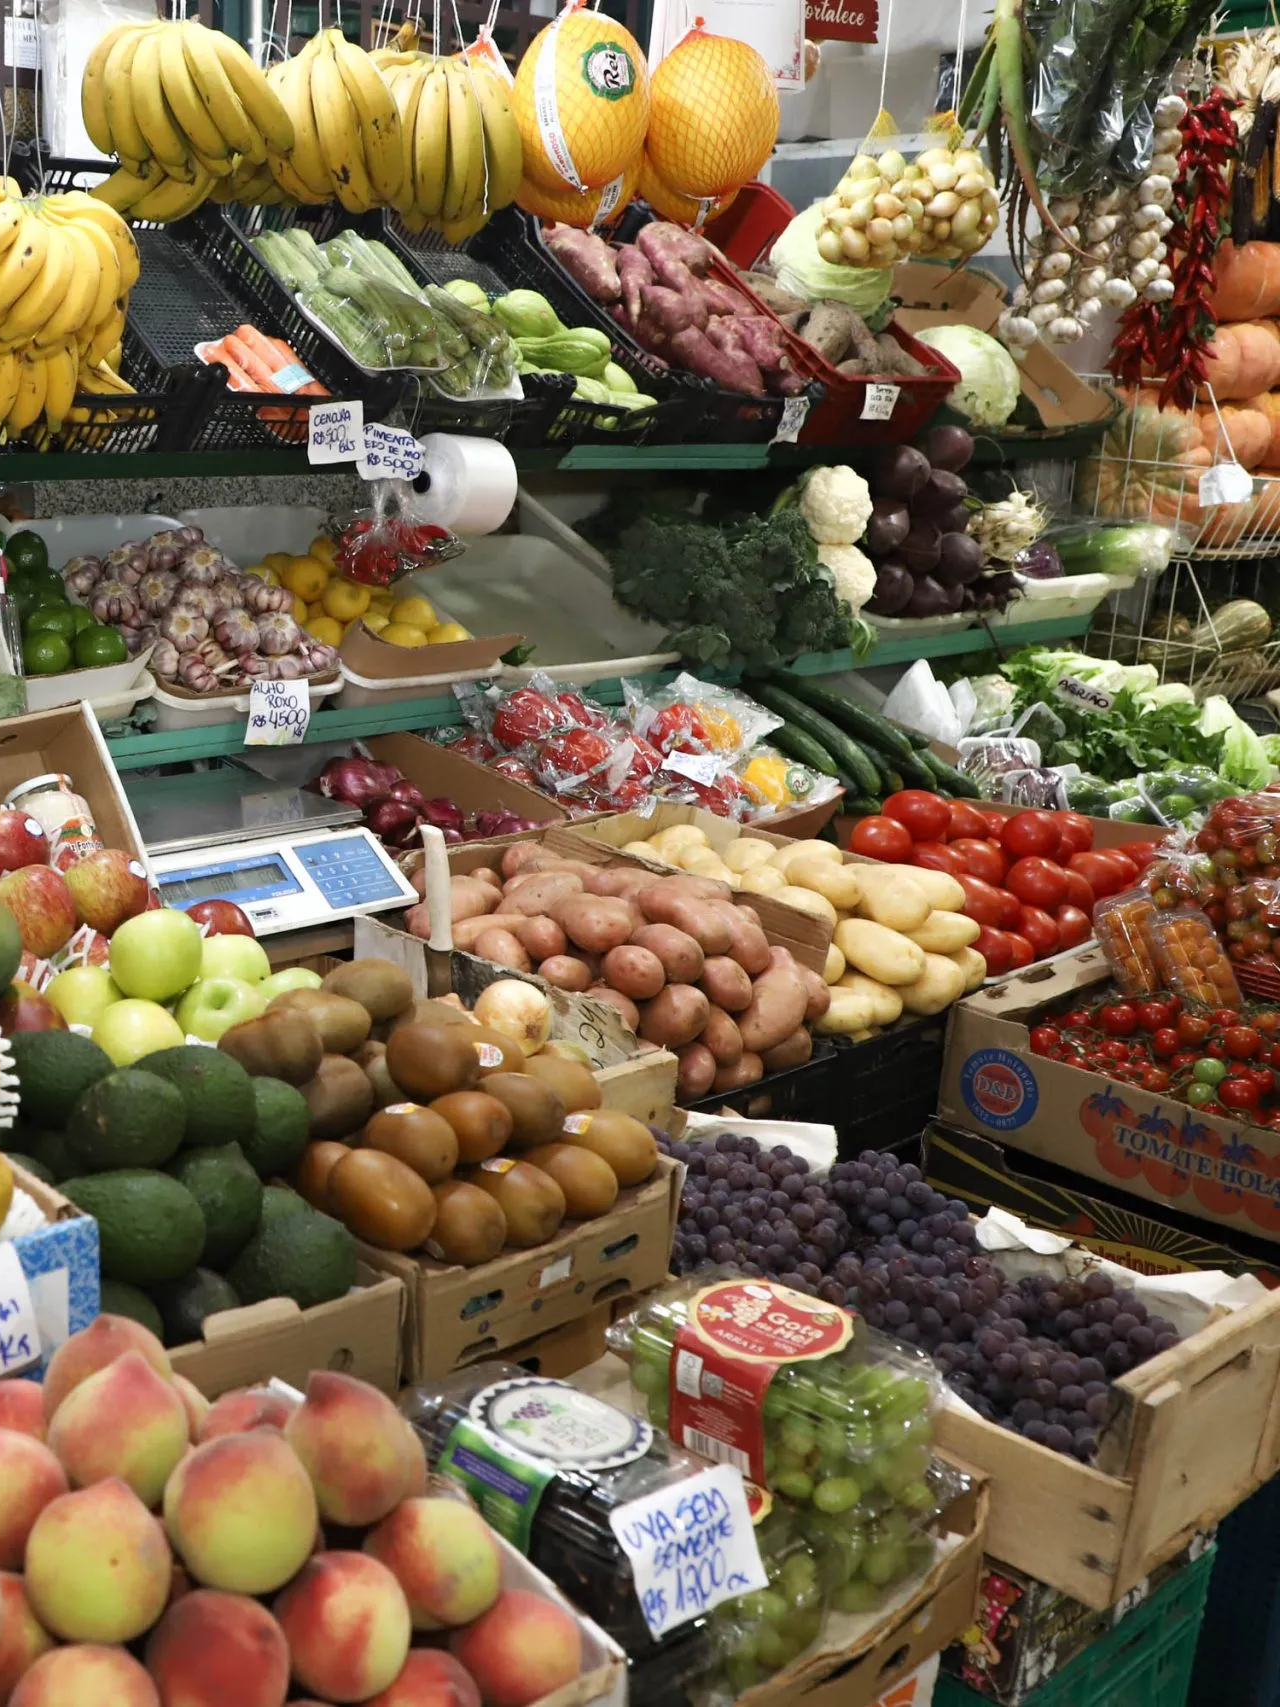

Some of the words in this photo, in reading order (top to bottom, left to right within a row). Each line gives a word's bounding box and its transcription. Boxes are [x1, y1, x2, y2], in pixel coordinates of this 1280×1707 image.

[804, 0, 865, 26] ortalece
[603, 52, 620, 88] Rei
[363, 425, 416, 448] PIMENTA
[388, 445, 400, 456] DE
[253, 681, 285, 695] ALHO
[265, 694, 298, 709] ROXO
[976, 1074, 1018, 1101] D&D
[1116, 1125, 1213, 1177] TOMATE
[1220, 1161, 1280, 1199] HOLA
[768, 1312, 825, 1339] Gota
[623, 1510, 676, 1550] UVA
[676, 1487, 730, 1532] SEM
